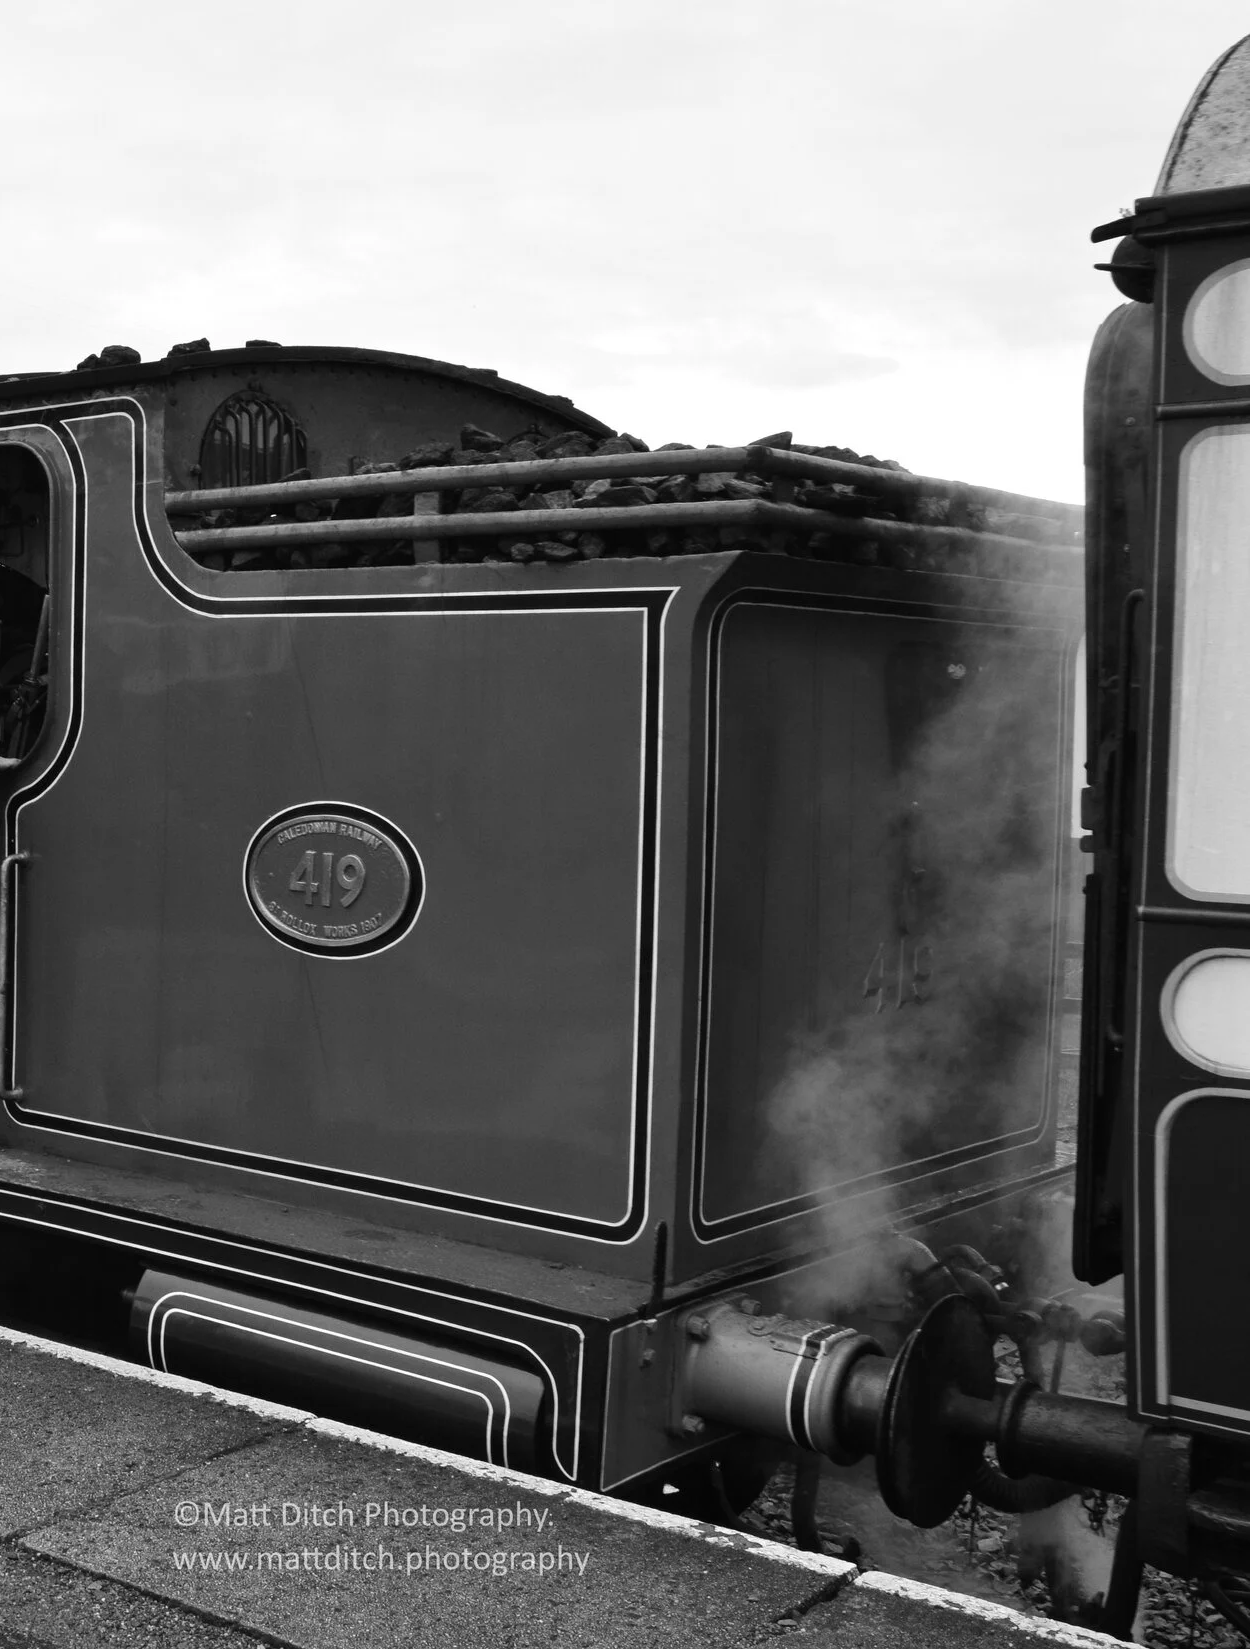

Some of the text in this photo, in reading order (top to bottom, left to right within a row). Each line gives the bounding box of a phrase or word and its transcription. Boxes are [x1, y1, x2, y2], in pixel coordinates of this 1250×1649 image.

[277, 821, 383, 850] CALEDONIAN RAILWAY
[289, 850, 366, 908] 419
[280, 910, 317, 936] ROLLOX
[324, 923, 358, 938] WORKS
[361, 912, 383, 933] 1907
